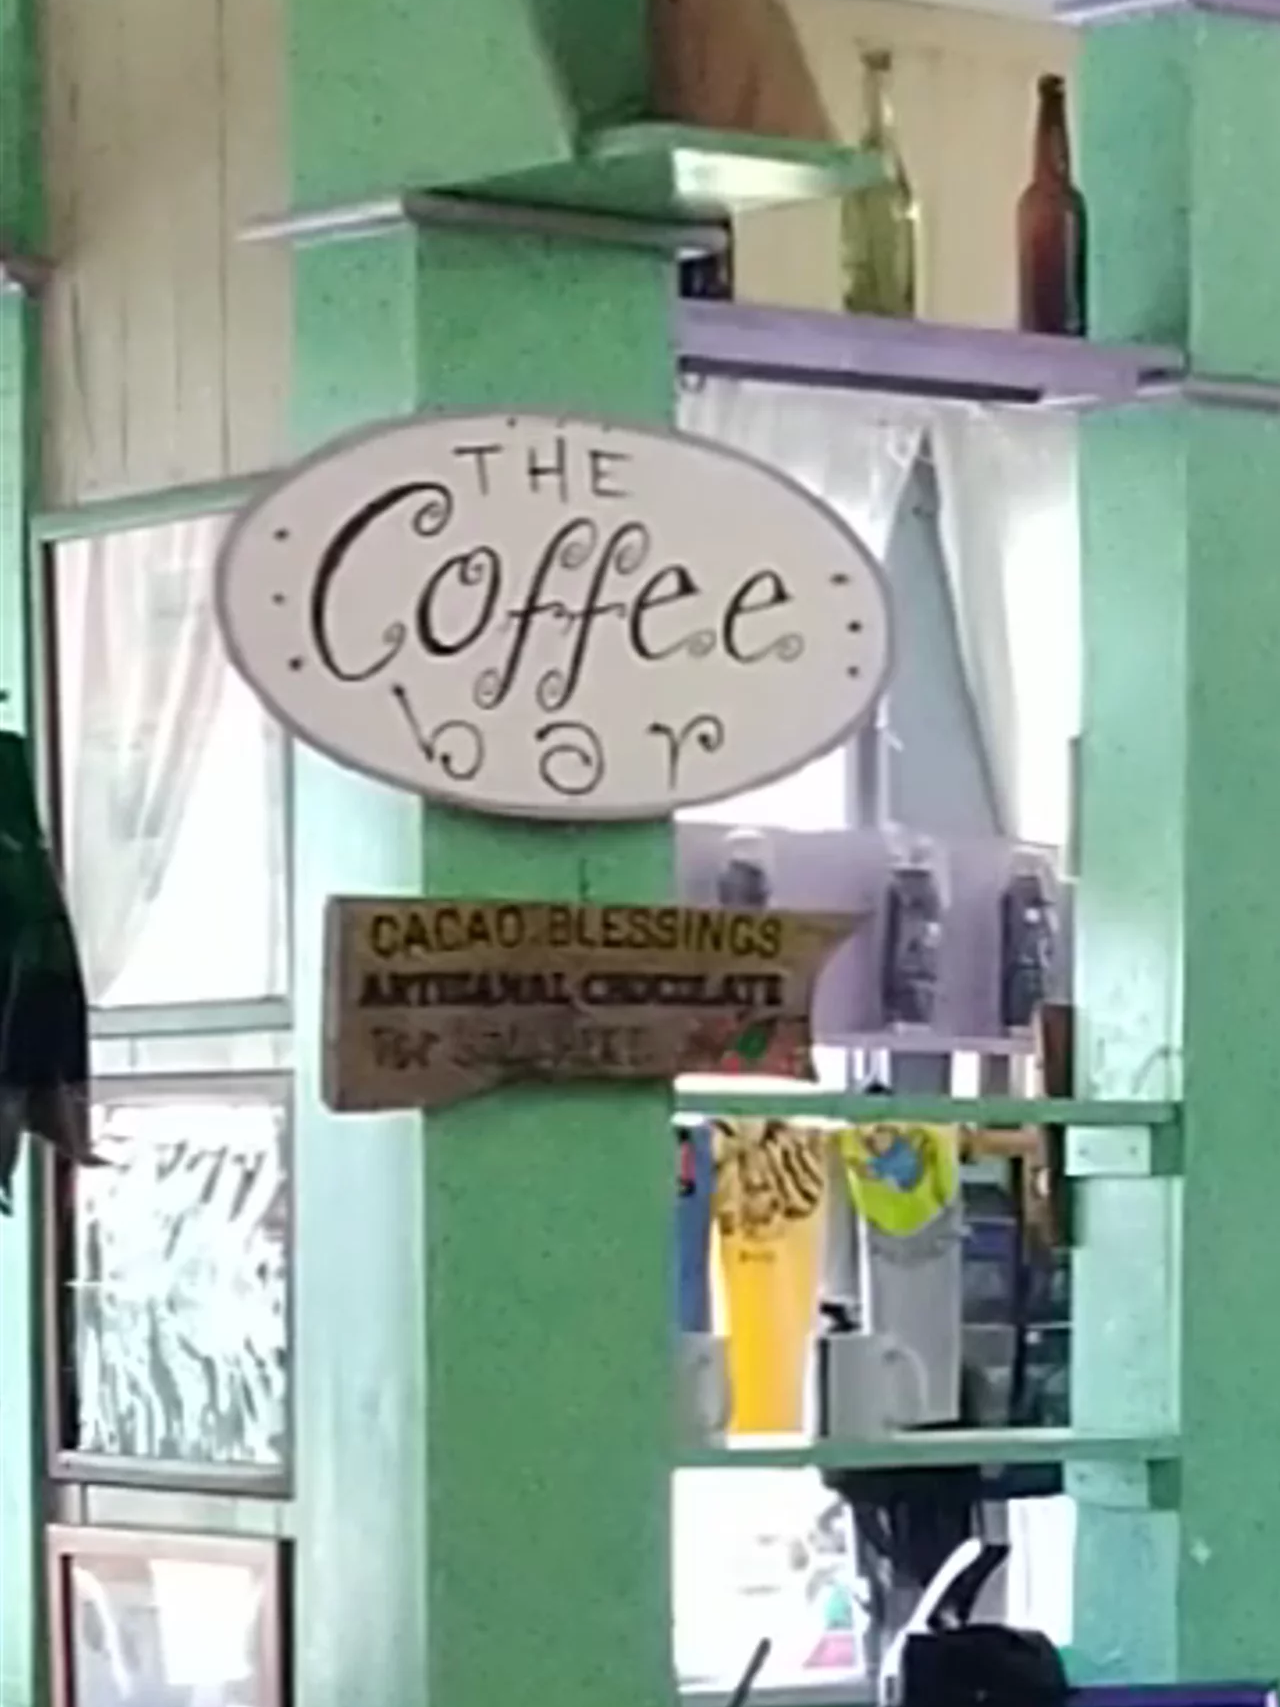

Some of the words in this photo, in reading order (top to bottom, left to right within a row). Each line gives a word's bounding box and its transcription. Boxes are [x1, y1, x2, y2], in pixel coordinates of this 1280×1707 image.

[453, 437, 636, 503] THE
[311, 481, 806, 713] Coffee
[394, 685, 725, 795] bar
[369, 906, 526, 959] CACAO
[548, 906, 783, 960] BLESSINGS
[581, 971, 783, 1008] CHOCOLATE
